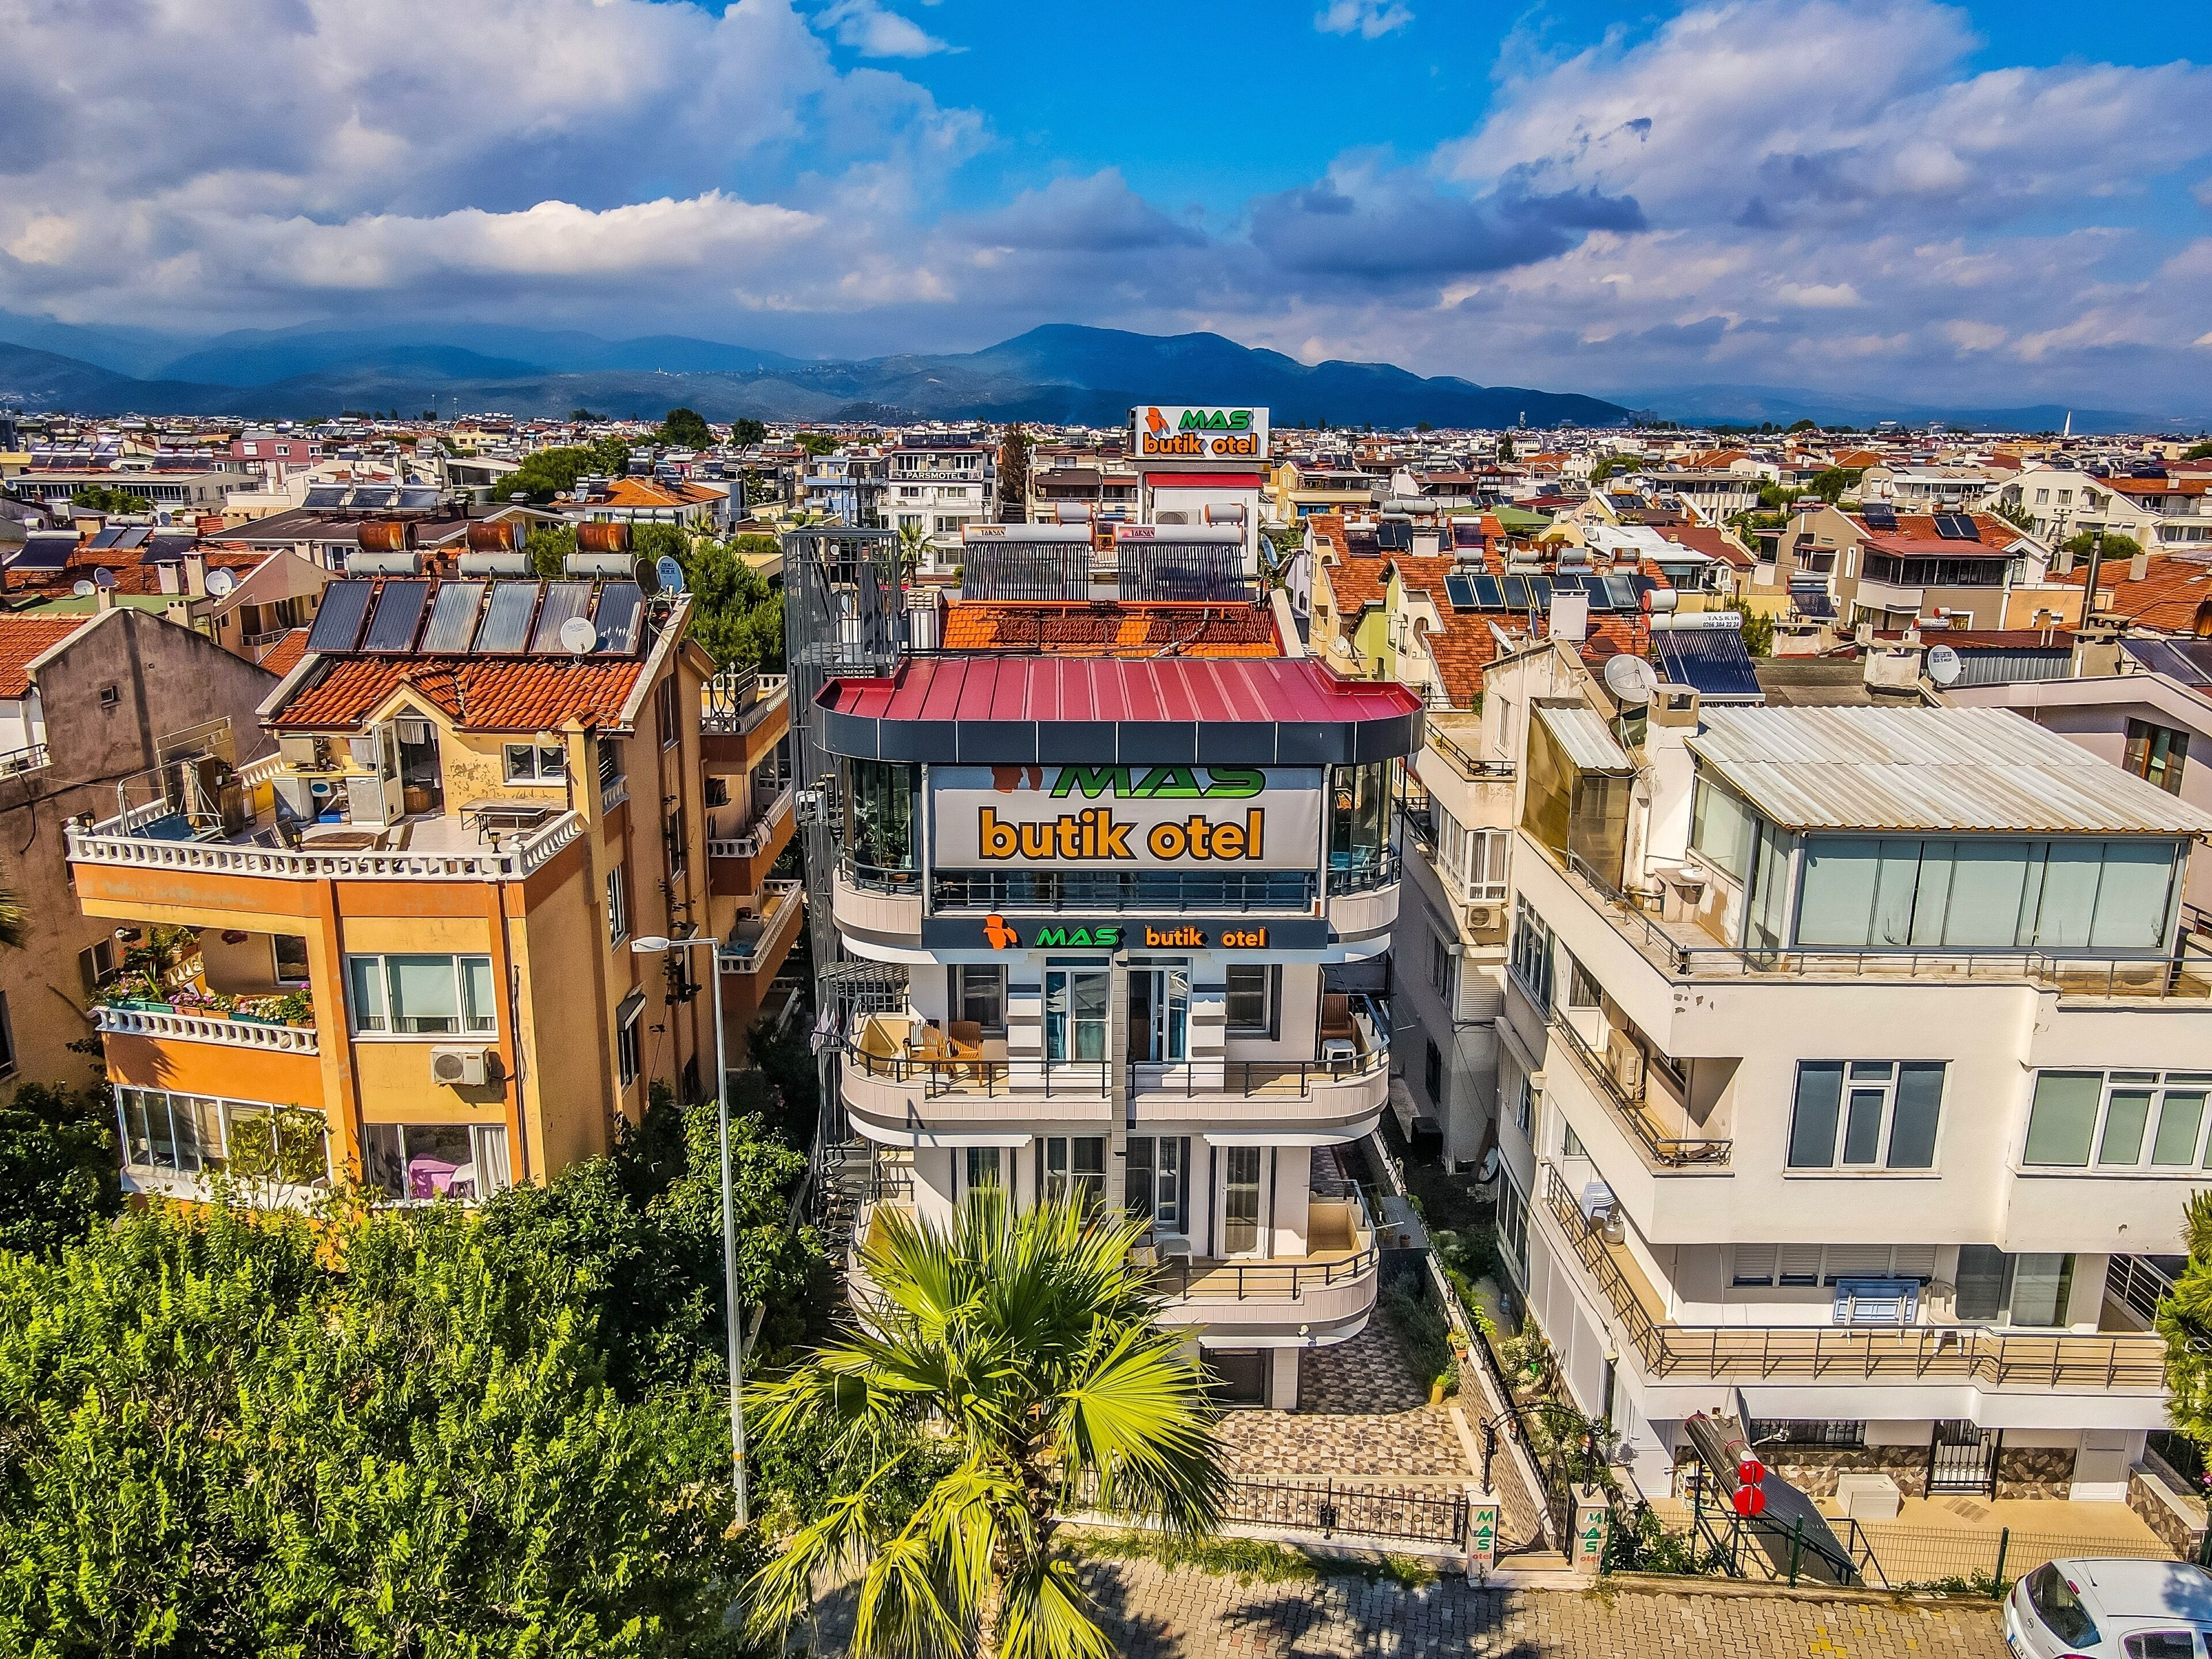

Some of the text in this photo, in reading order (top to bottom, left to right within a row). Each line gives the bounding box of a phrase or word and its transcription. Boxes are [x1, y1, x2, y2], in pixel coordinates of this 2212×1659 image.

[1178, 410, 1252, 430] MAS
[1143, 432, 1257, 454] butik otel
[1048, 767, 1267, 799] MAS
[979, 806, 1266, 861] butik otel
[1036, 926, 1267, 948] MAS butik otel
[1476, 1509, 1494, 1551] MAS
[1582, 1511, 1603, 1552] MAS
